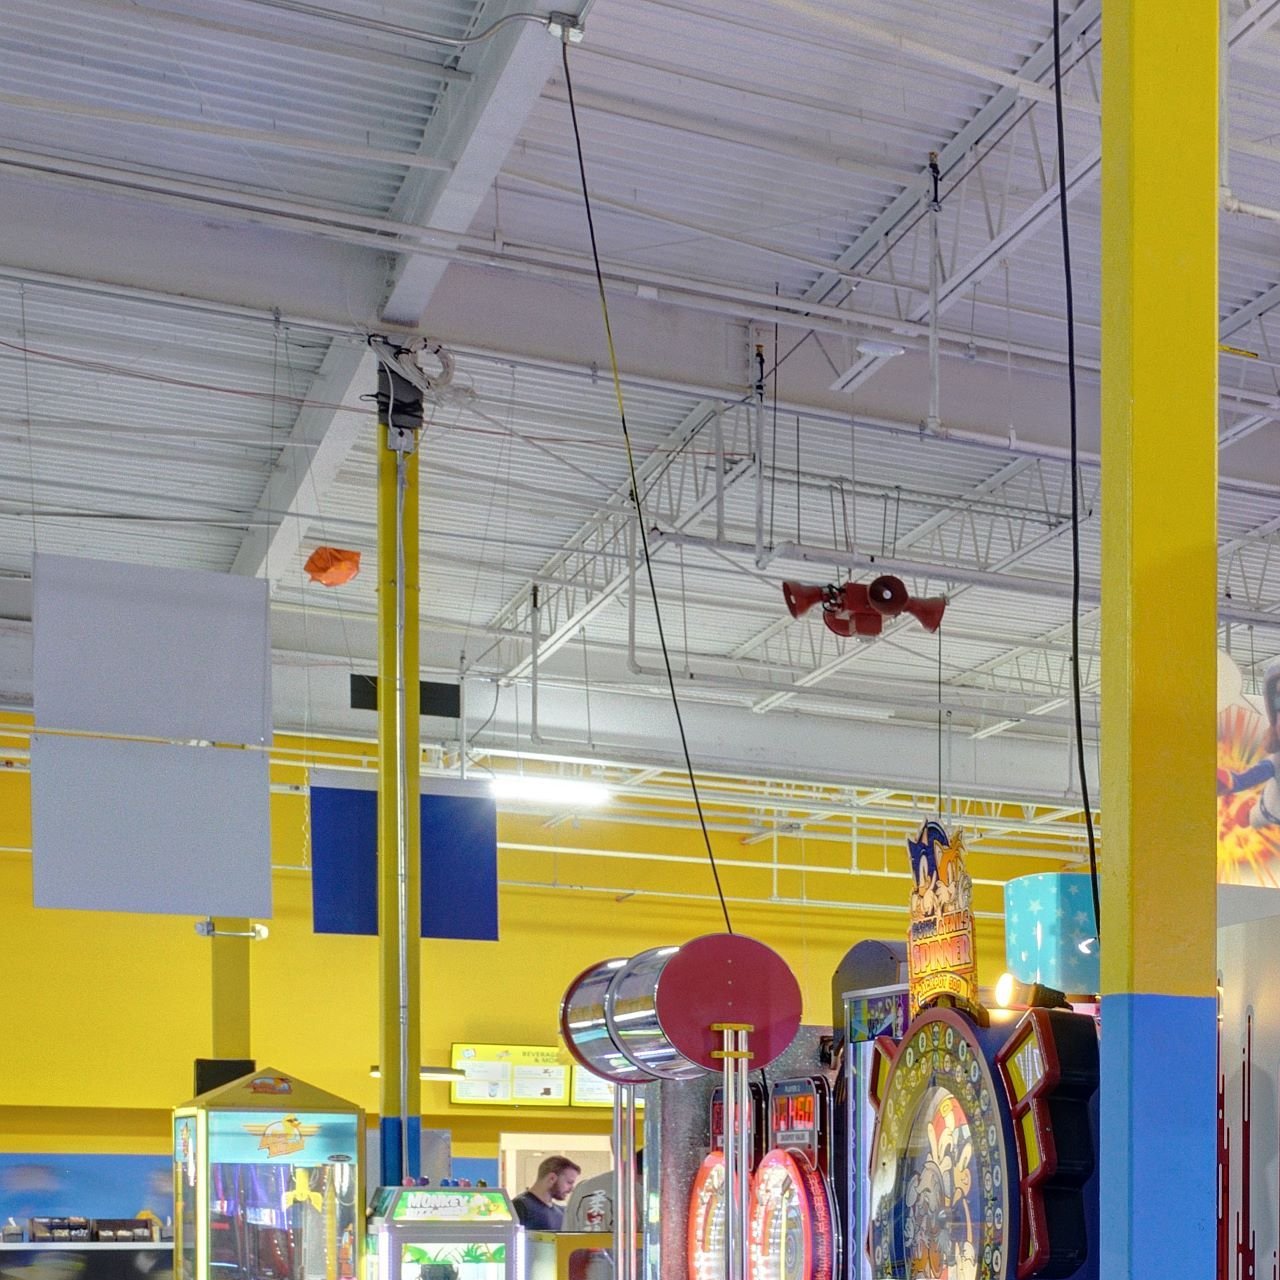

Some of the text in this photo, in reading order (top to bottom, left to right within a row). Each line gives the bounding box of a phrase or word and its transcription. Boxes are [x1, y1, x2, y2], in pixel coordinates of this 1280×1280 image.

[913, 934, 971, 975] SPINNER
[920, 975, 947, 998] JACKPOT
[408, 1192, 469, 1208] MONKEY
